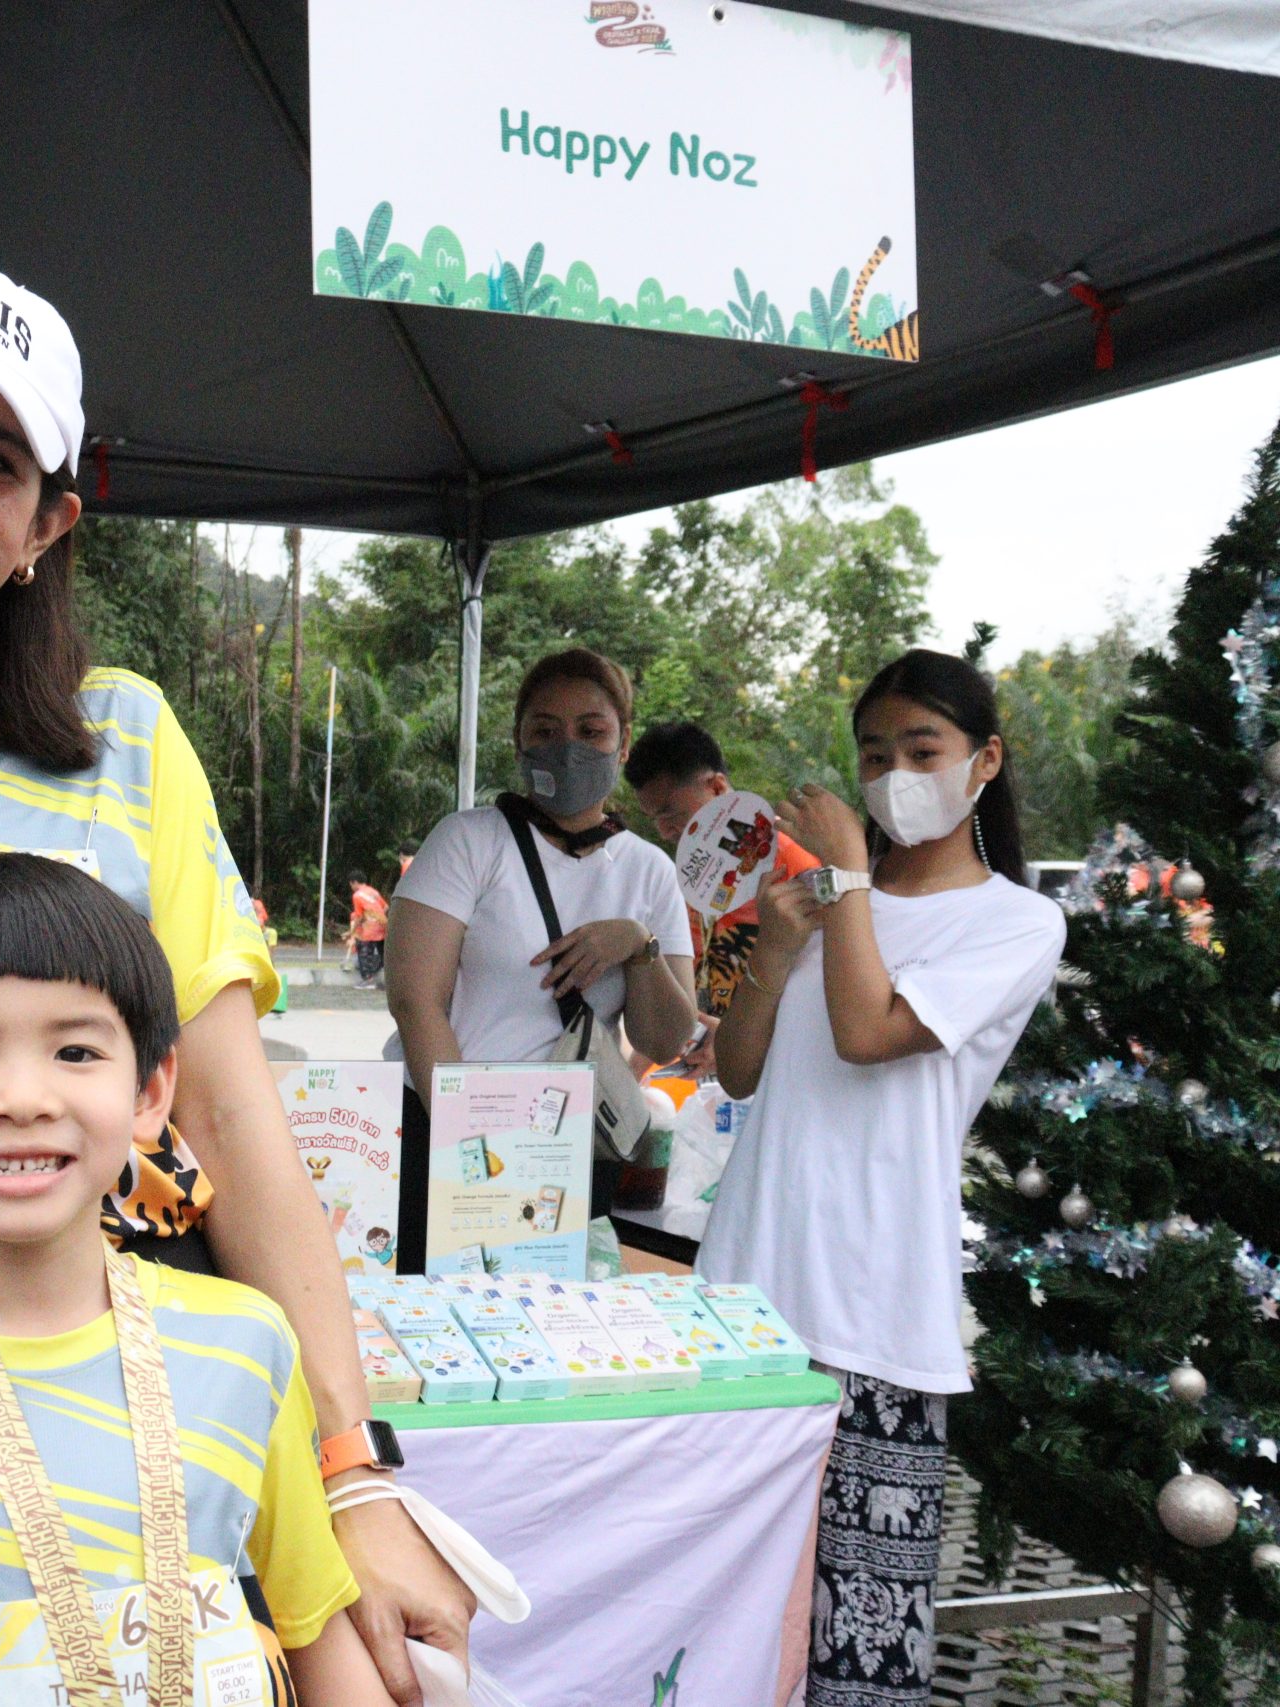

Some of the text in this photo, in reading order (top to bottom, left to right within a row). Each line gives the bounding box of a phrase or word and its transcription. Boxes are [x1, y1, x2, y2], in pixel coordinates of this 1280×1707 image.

[500, 107, 758, 187] Happy Noz
[308, 1069, 336, 1077] HAPPY
[330, 1107, 359, 1128] 500
[360, 1143, 368, 1156] 1
[136, 1370, 163, 1418] 2022
[142, 1420, 177, 1526] CHALLENGE
[154, 1527, 180, 1582] TRAIL
[5, 1463, 43, 1519] TRAIL
[25, 1517, 85, 1628] CHALLENGE
[60, 1624, 100, 1681] 2022
[211, 1661, 254, 1678] START TIME
[217, 1676, 246, 1691] 06.00
[223, 1689, 250, 1704] 06.12
